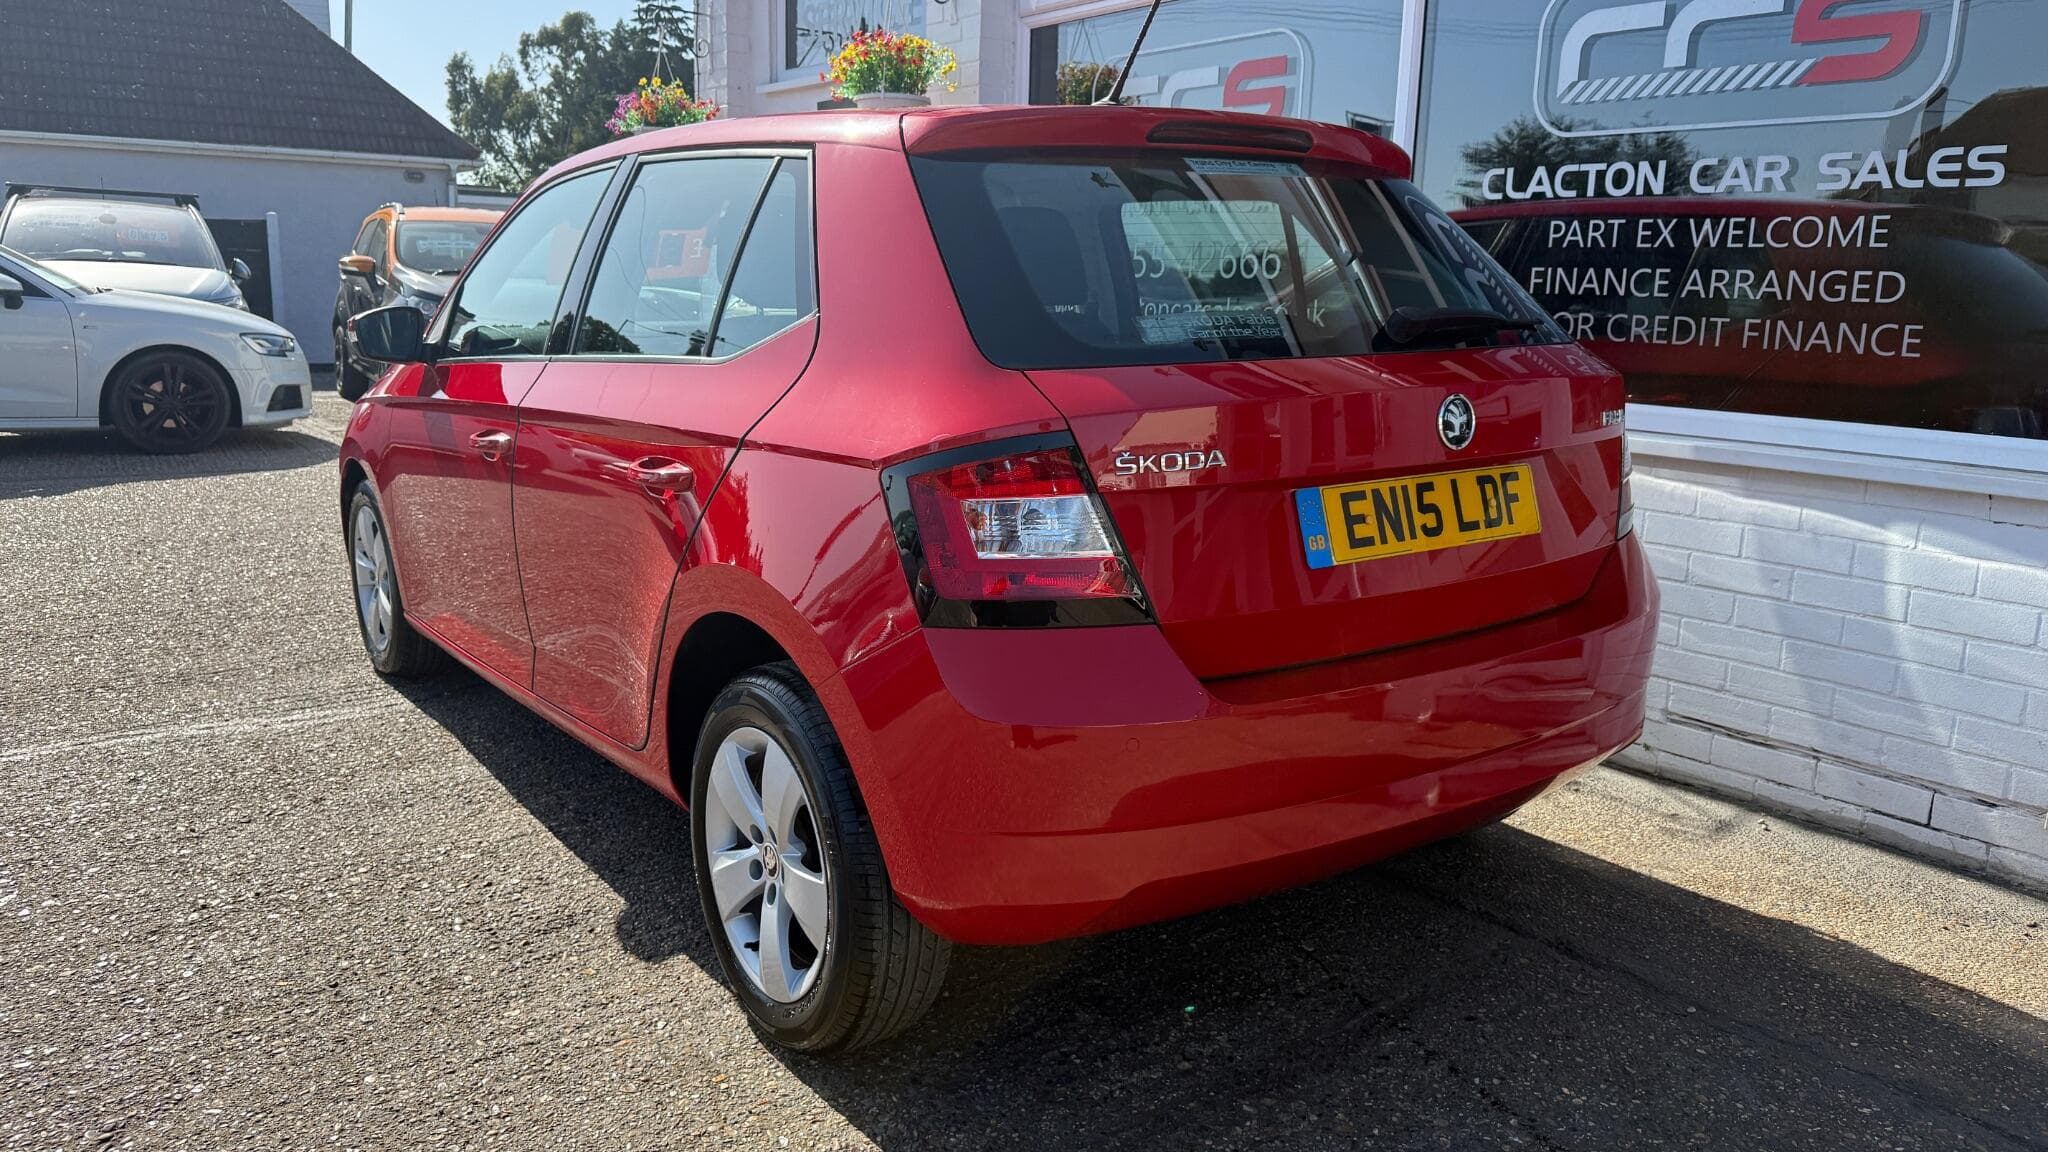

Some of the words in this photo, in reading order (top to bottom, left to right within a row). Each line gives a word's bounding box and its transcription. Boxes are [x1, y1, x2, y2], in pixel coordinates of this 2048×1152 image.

[1481, 159, 1667, 200] CLACTON
[1690, 154, 1792, 193] CAR
[1816, 144, 2009, 191] SALES
[1547, 218, 1626, 248] PART
[1636, 218, 1677, 248] EX
[1689, 214, 1891, 249] WELCOME
[1528, 266, 1671, 298] FINANCE
[1680, 269, 1907, 303] ARRANGED
[1606, 313, 1731, 347] CREDIT
[1742, 318, 1925, 358] FINANCE
[1115, 449, 1227, 477] ŠKODA
[1339, 481, 1444, 550] EN15
[1449, 471, 1520, 533] LDF
[1308, 534, 1326, 551] GB
